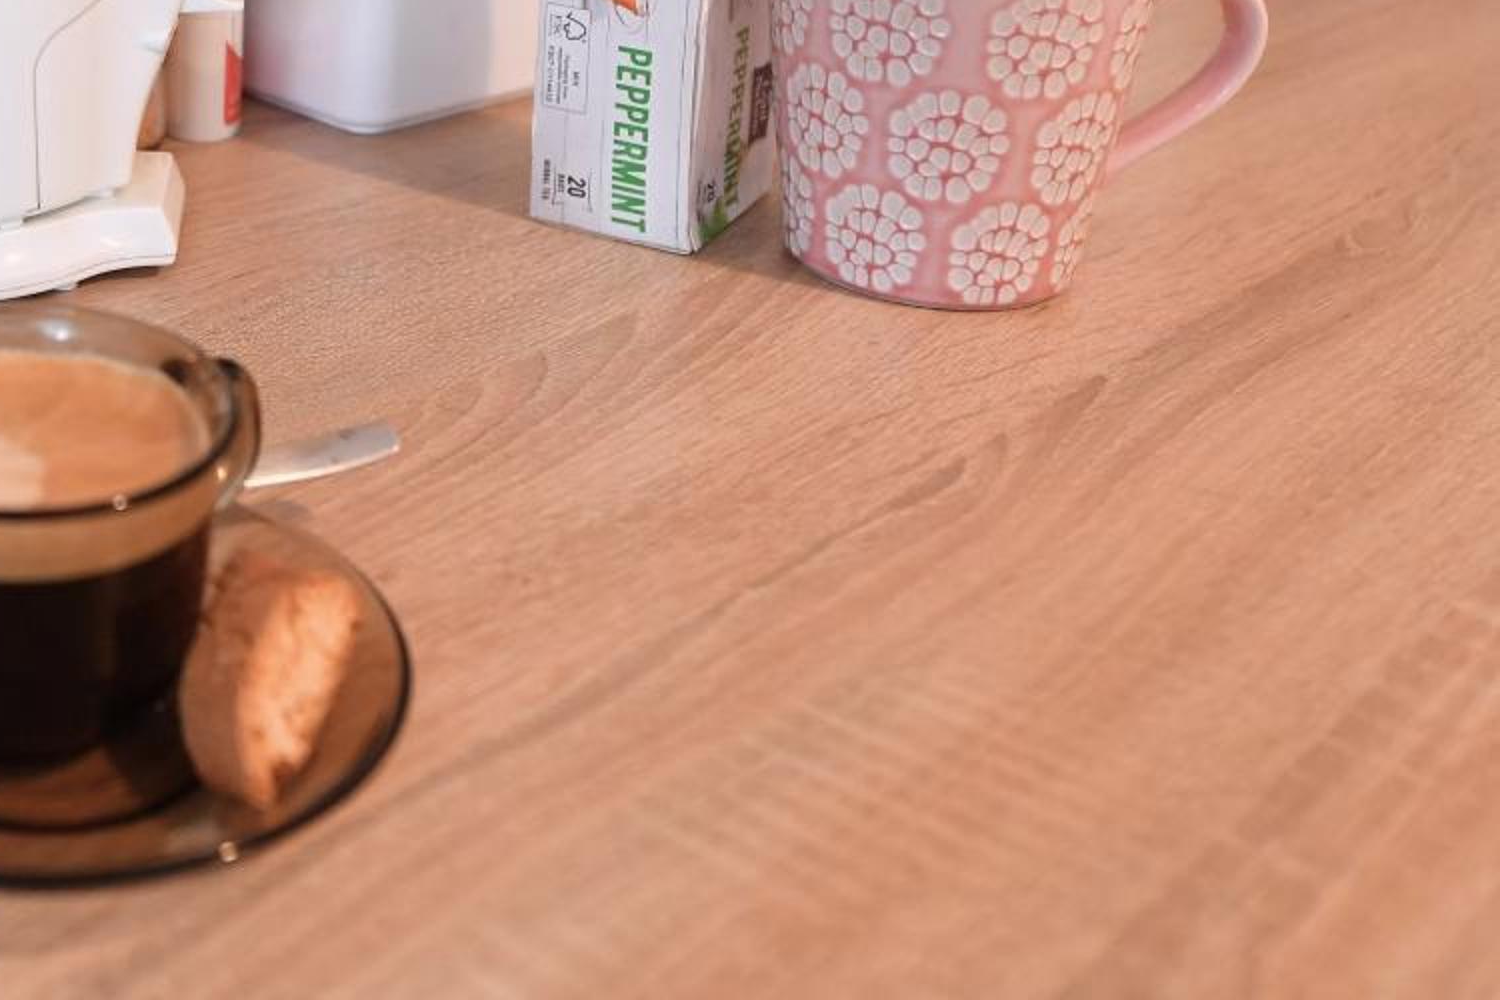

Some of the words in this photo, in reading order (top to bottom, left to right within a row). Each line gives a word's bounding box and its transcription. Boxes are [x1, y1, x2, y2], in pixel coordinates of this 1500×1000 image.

[567, 175, 586, 198] 20
[611, 45, 652, 233] PEPPERMINT
[723, 25, 750, 206] PEPPERMINT
